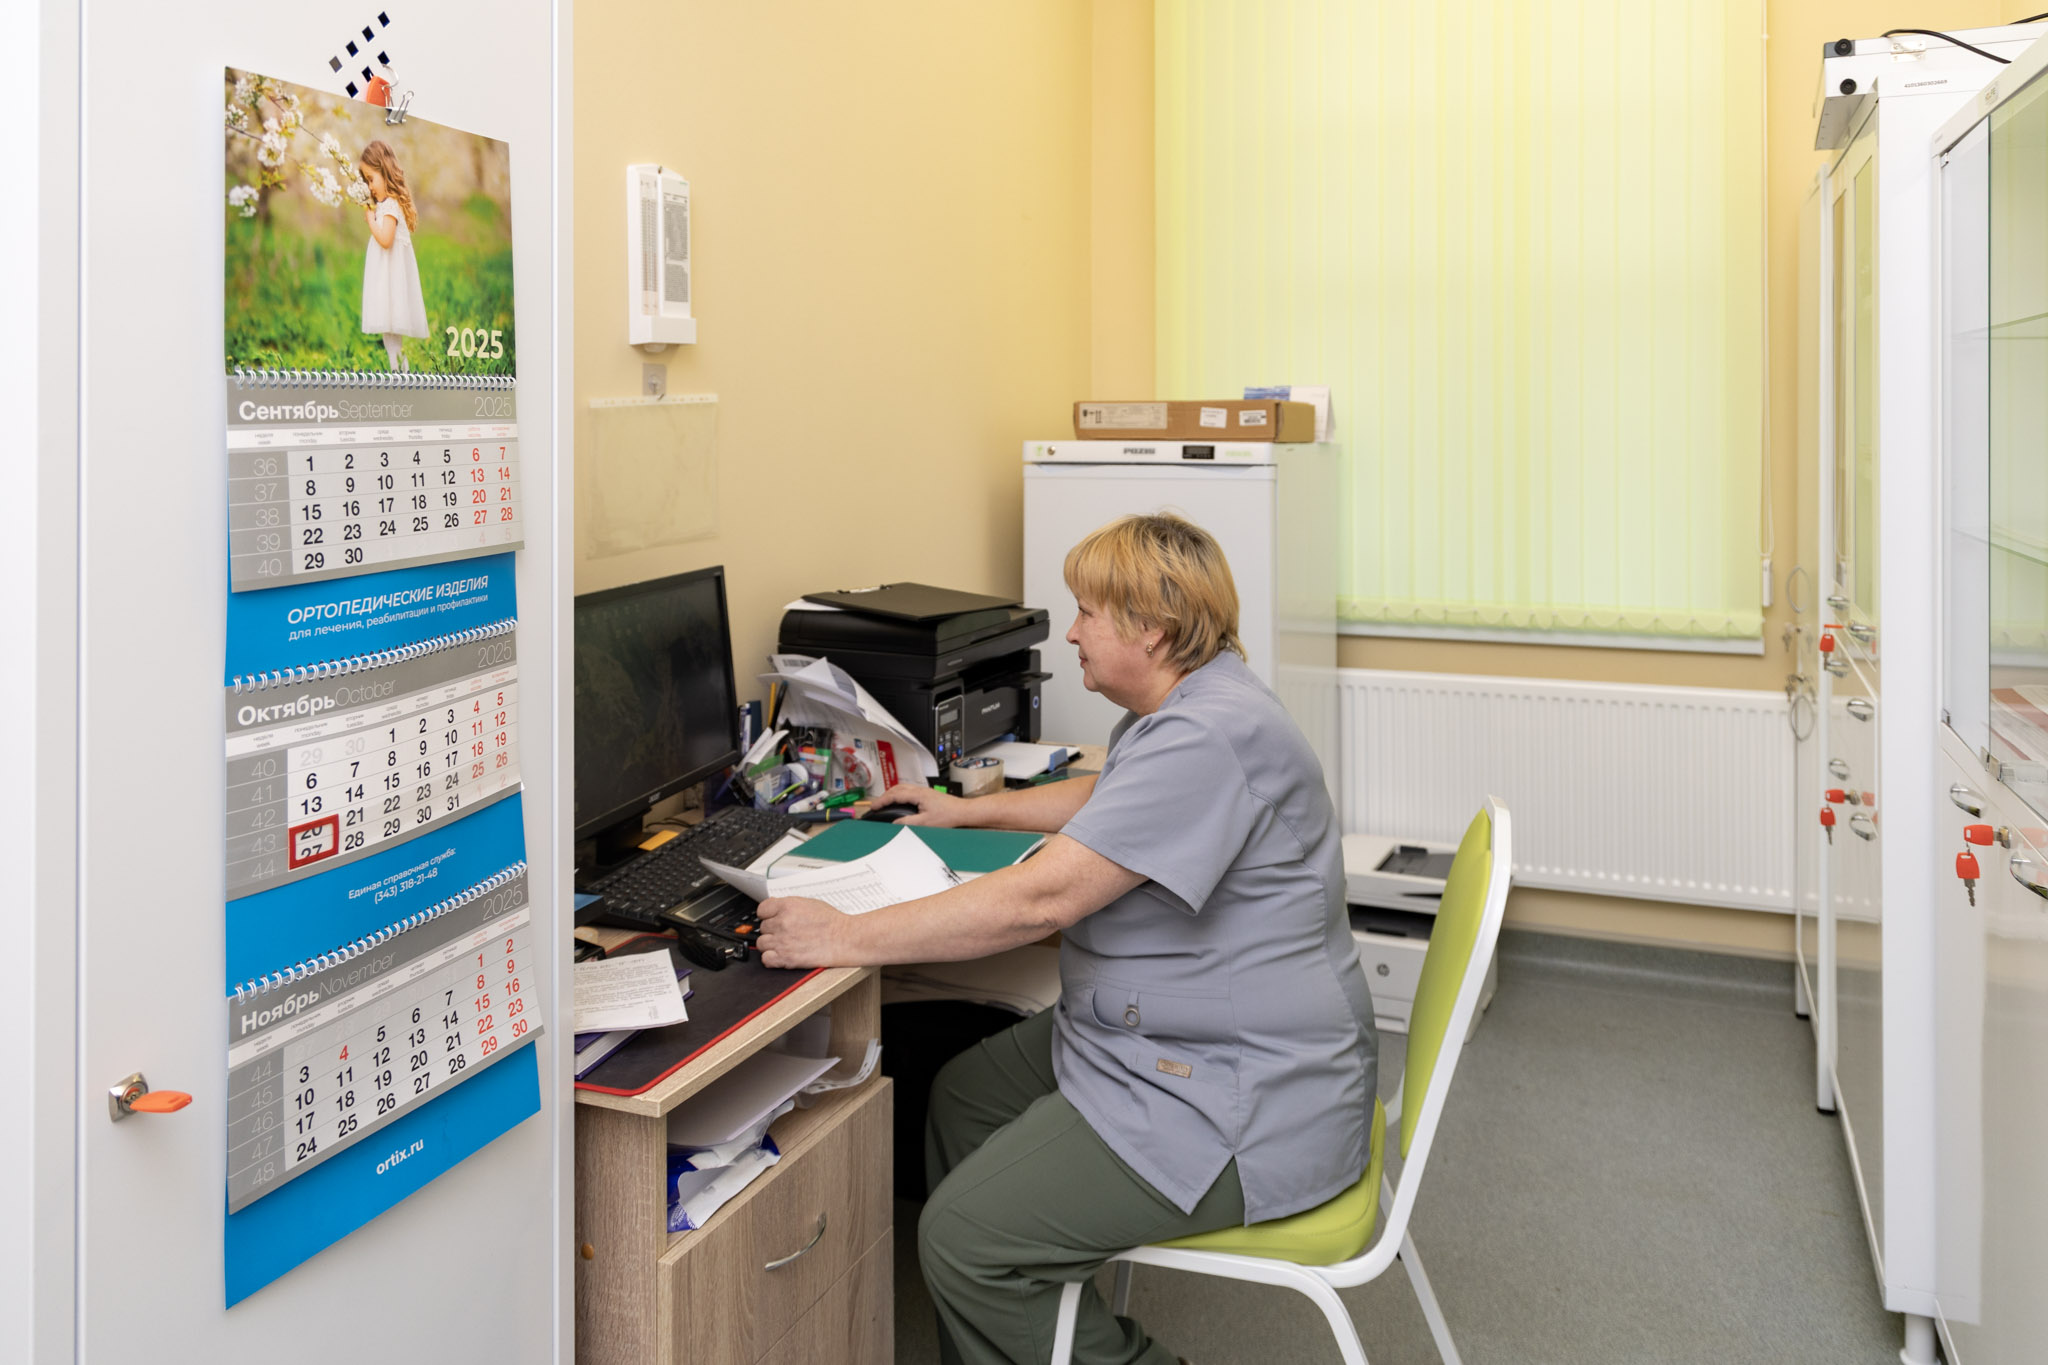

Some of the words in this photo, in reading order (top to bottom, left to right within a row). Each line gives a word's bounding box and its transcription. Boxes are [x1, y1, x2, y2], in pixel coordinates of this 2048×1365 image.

[446, 327, 503, 359] 2025
[239, 401, 338, 423] Сентябрь
[339, 400, 414, 421] September
[475, 396, 512, 417] 2025
[254, 458, 277, 476] 36
[307, 456, 313, 471] 1
[345, 454, 354, 469] 2
[381, 452, 388, 467] 3
[413, 451, 420, 464] 4
[444, 450, 450, 463] 5
[473, 448, 480, 461] 6
[500, 447, 505, 460] 7
[255, 483, 277, 501] 37
[306, 480, 316, 496] 8
[346, 478, 354, 492] 9
[378, 475, 393, 490] 10
[412, 473, 424, 487] 11
[442, 470, 455, 484] 12
[471, 468, 484, 482] 13
[498, 467, 510, 480] 14
[256, 508, 279, 526] 38
[302, 504, 321, 520] 15
[343, 501, 360, 516] 16
[379, 498, 394, 513] 17
[412, 495, 426, 509] 18
[443, 492, 456, 506] 19
[472, 489, 486, 503] 20
[501, 488, 511, 500] 21
[257, 533, 280, 551] 39
[304, 528, 323, 545] 22
[344, 524, 361, 540] 23
[380, 520, 396, 536] 24
[413, 517, 428, 532] 25
[444, 513, 459, 528] 26
[474, 510, 487, 524] 27
[501, 507, 512, 521] 28
[258, 558, 282, 576] 40
[305, 553, 324, 570] 29
[345, 548, 362, 564] 30
[288, 586, 433, 625] ОРТОПЕДИЧЕСКИЕ
[436, 575, 489, 598] ИЗДЕЛИЯ
[289, 629, 311, 642] для
[315, 619, 364, 637] лечения,
[367, 607, 428, 628] реабилитации
[430, 605, 435, 614] и
[437, 593, 488, 613] профилактики
[237, 693, 335, 726] Октябрь
[335, 679, 395, 706] October
[478, 641, 512, 669] 2025
[252, 759, 276, 778] 40
[301, 748, 322, 766] 29
[346, 737, 365, 755] 30
[390, 728, 394, 742] 1
[420, 718, 426, 733] 2
[448, 709, 454, 723] 3
[474, 700, 480, 713] 4
[498, 692, 503, 706] 5
[252, 786, 274, 803] 41
[306, 773, 317, 789] 6
[351, 762, 359, 777] 7
[388, 751, 396, 766] 8
[420, 740, 426, 755] 9
[445, 730, 457, 745] 10
[472, 720, 482, 736] 11
[495, 712, 506, 726] 12
[252, 809, 275, 828] 42
[301, 796, 322, 814] 13
[346, 784, 364, 802] 14
[384, 772, 400, 790] 15
[417, 762, 430, 778] 16
[446, 751, 458, 767] 17
[472, 741, 483, 757] 18
[496, 732, 506, 747] 19
[252, 834, 275, 853] 43
[346, 807, 363, 826] 21
[384, 795, 400, 814] 22
[417, 784, 431, 802] 23
[446, 772, 459, 790] 24
[472, 762, 484, 779] 25
[496, 752, 507, 768] 26
[252, 860, 276, 879] 44
[345, 831, 364, 851] 28
[384, 818, 400, 837] 29
[417, 806, 431, 823] 30
[448, 794, 459, 811] 31
[348, 881, 381, 899] Единая
[383, 861, 428, 887] справочная
[431, 848, 456, 865] служба:
[375, 886, 398, 904] (343)
[399, 868, 438, 894] 318-21-48
[241, 991, 319, 1035] Ноябрь
[320, 952, 395, 996] November
[483, 884, 523, 920] 2025
[252, 1061, 273, 1083] 44
[478, 954, 482, 967] 1
[506, 939, 513, 953] 2
[253, 1085, 274, 1108] 45
[300, 1066, 309, 1083] 3
[340, 1046, 348, 1060] 4
[377, 1026, 385, 1042] 5
[412, 1008, 420, 1023] 6
[446, 990, 453, 1006] 7
[477, 975, 484, 989] 8
[507, 960, 514, 973] 9
[253, 1111, 275, 1134] 46
[296, 1088, 314, 1110] 10
[337, 1067, 352, 1087] 11
[373, 1047, 390, 1067] 12
[409, 1028, 425, 1047] 13
[443, 1011, 458, 1029] 14
[475, 994, 490, 1012] 15
[506, 978, 519, 995] 16
[253, 1138, 274, 1160] 47
[296, 1112, 314, 1134] 17
[336, 1091, 354, 1111] 18
[374, 1070, 391, 1090] 19
[411, 1050, 427, 1071] 20
[446, 1032, 461, 1052] 21
[478, 1015, 494, 1034] 22
[508, 998, 523, 1017] 23
[253, 1162, 276, 1186] 48
[297, 1137, 317, 1161] 24
[338, 1114, 357, 1138] 25
[377, 1093, 395, 1115] 26
[414, 1072, 430, 1094] 27
[449, 1054, 465, 1074] 28
[482, 1036, 498, 1056] 29
[512, 1019, 527, 1037] 30
[376, 1139, 424, 1175] ortix.ru
